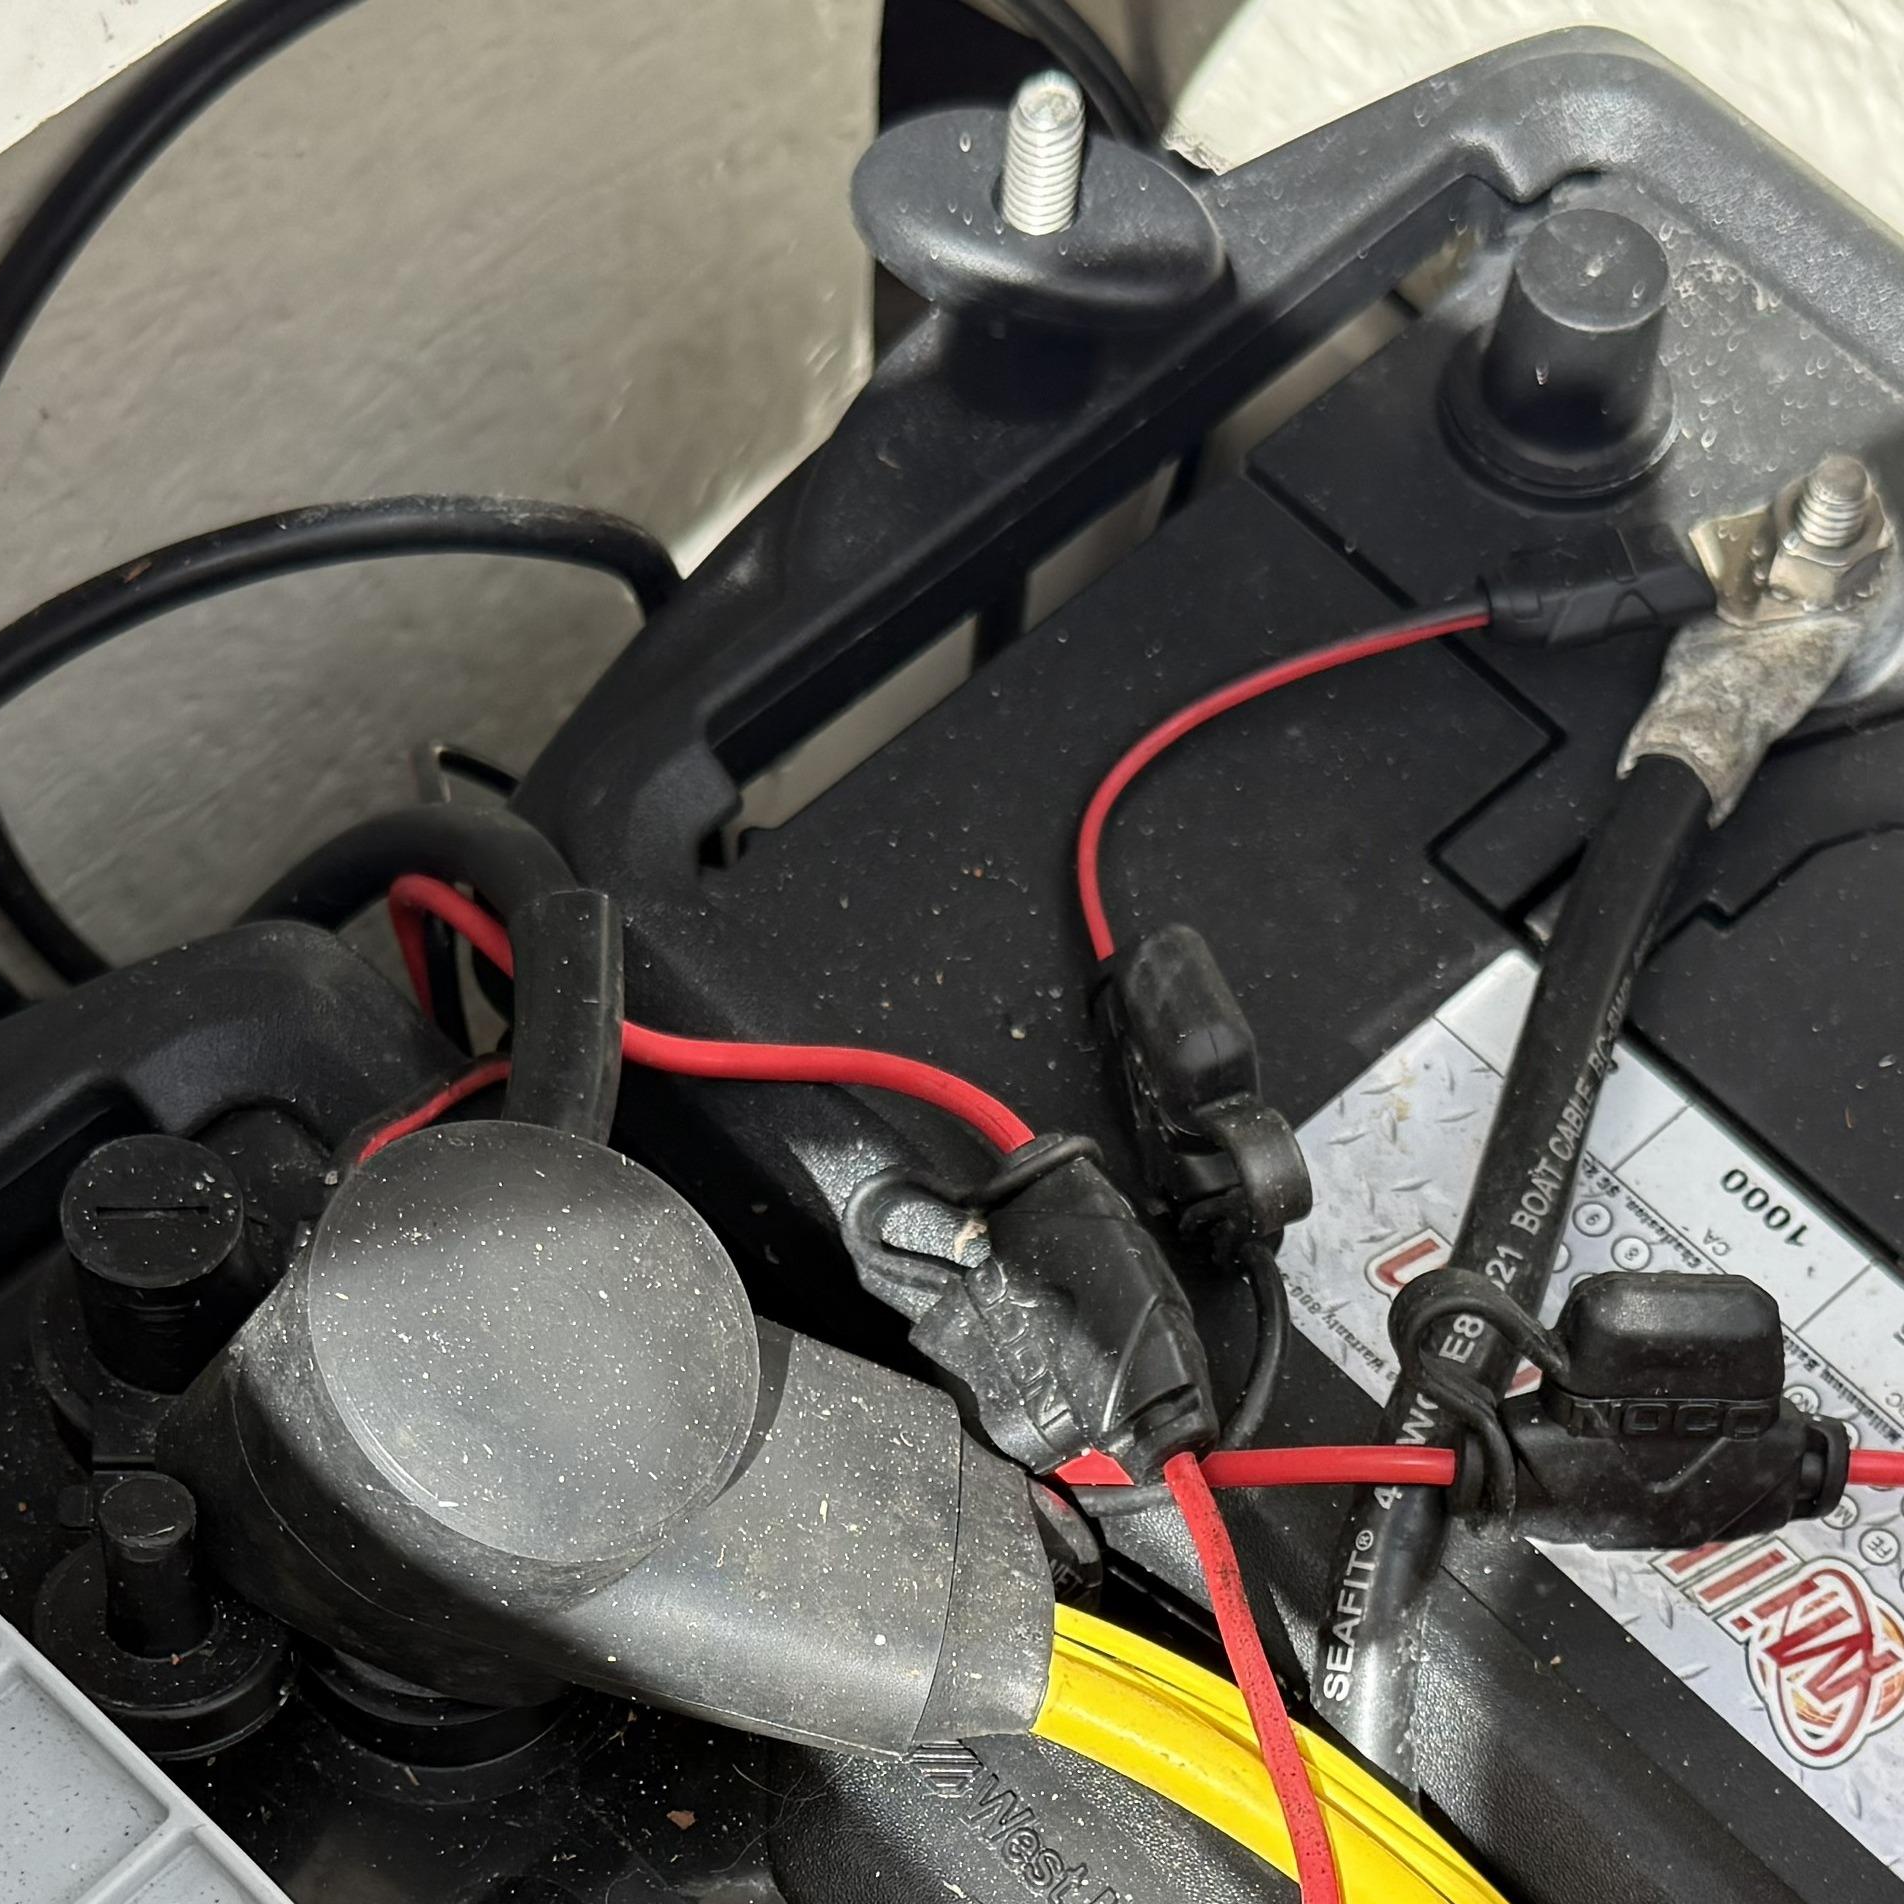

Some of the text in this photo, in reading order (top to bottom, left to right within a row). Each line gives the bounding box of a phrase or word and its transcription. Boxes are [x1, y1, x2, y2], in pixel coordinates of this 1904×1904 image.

[1508, 1153, 1568, 1236] BOAT
[1545, 1075, 1602, 1162] CABLE
[1715, 1164, 1815, 1251] 1000
[1697, 1226, 1734, 1260] CA
[966, 1772, 1086, 1904] West
